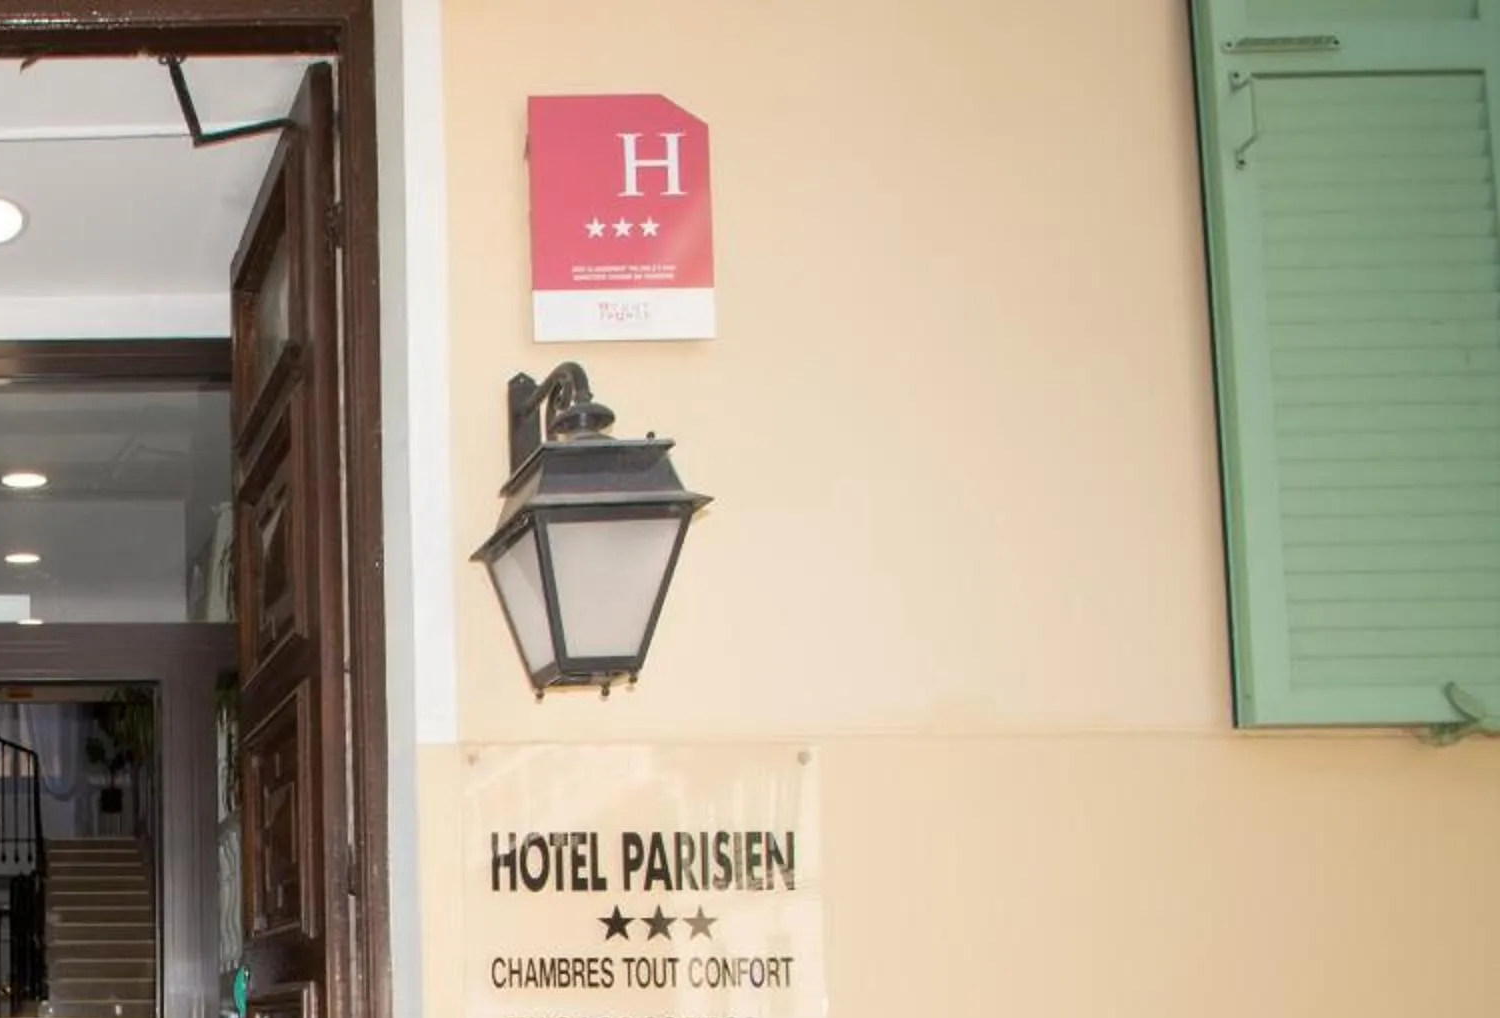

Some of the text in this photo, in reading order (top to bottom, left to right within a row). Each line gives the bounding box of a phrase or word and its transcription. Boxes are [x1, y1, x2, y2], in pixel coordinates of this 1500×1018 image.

[615, 131, 689, 198] H
[490, 830, 796, 893] HOTEL PARISIEN
[490, 956, 795, 990] CHAMBRES TOUT CONFORT
